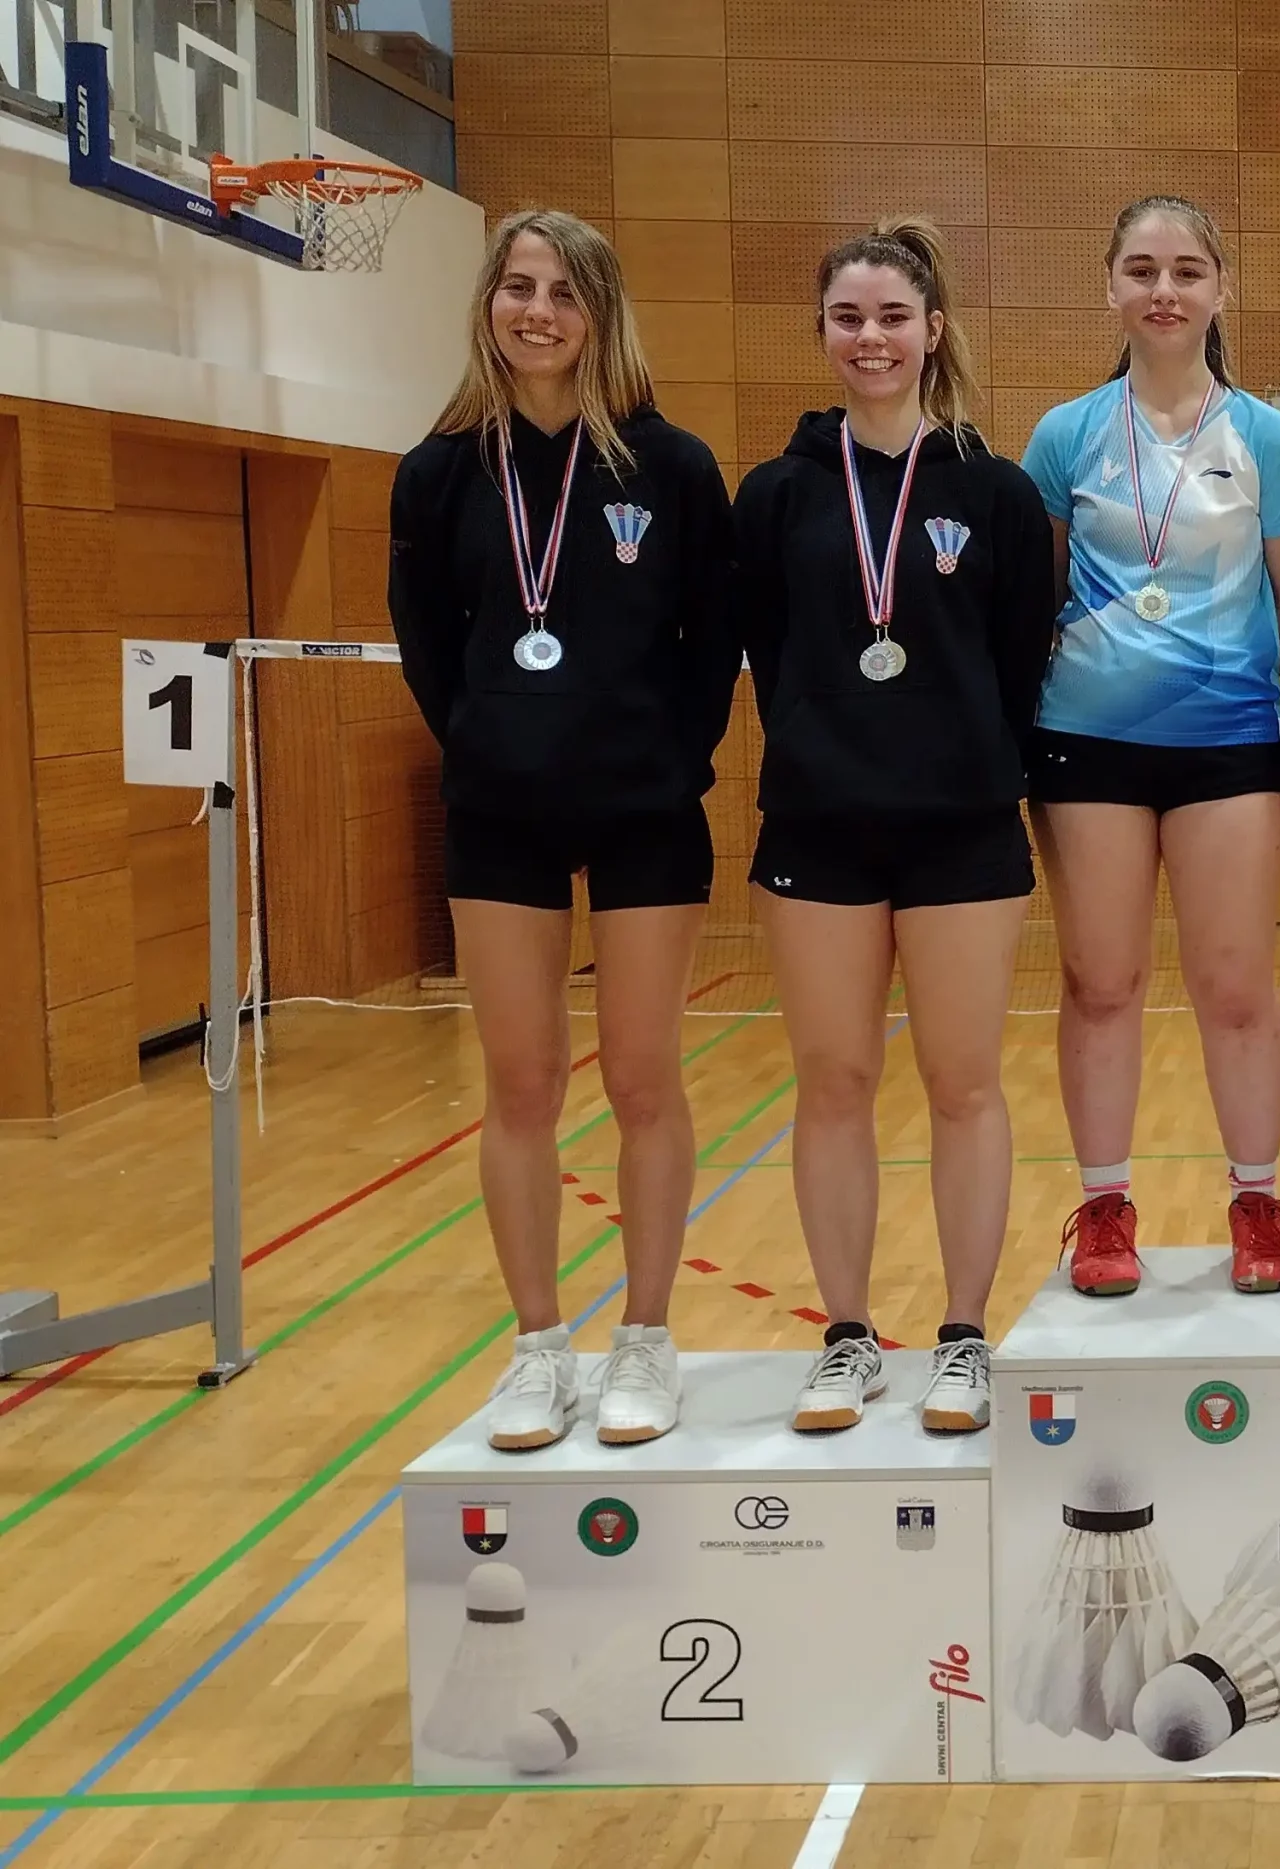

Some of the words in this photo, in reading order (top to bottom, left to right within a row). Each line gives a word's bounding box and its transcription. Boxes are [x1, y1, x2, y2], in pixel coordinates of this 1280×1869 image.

[77, 84, 90, 157] elan
[187, 200, 213, 217] elan
[319, 646, 360, 655] VICTOR
[149, 675, 192, 750] 1
[700, 1540, 741, 1548] CROATIA
[743, 1540, 804, 1548] OSIGURANJE
[661, 1618, 743, 1721] 2
[928, 1644, 986, 1703] filo
[937, 1701, 946, 1742] CENTAR
[937, 1744, 946, 1776] DRVNI
